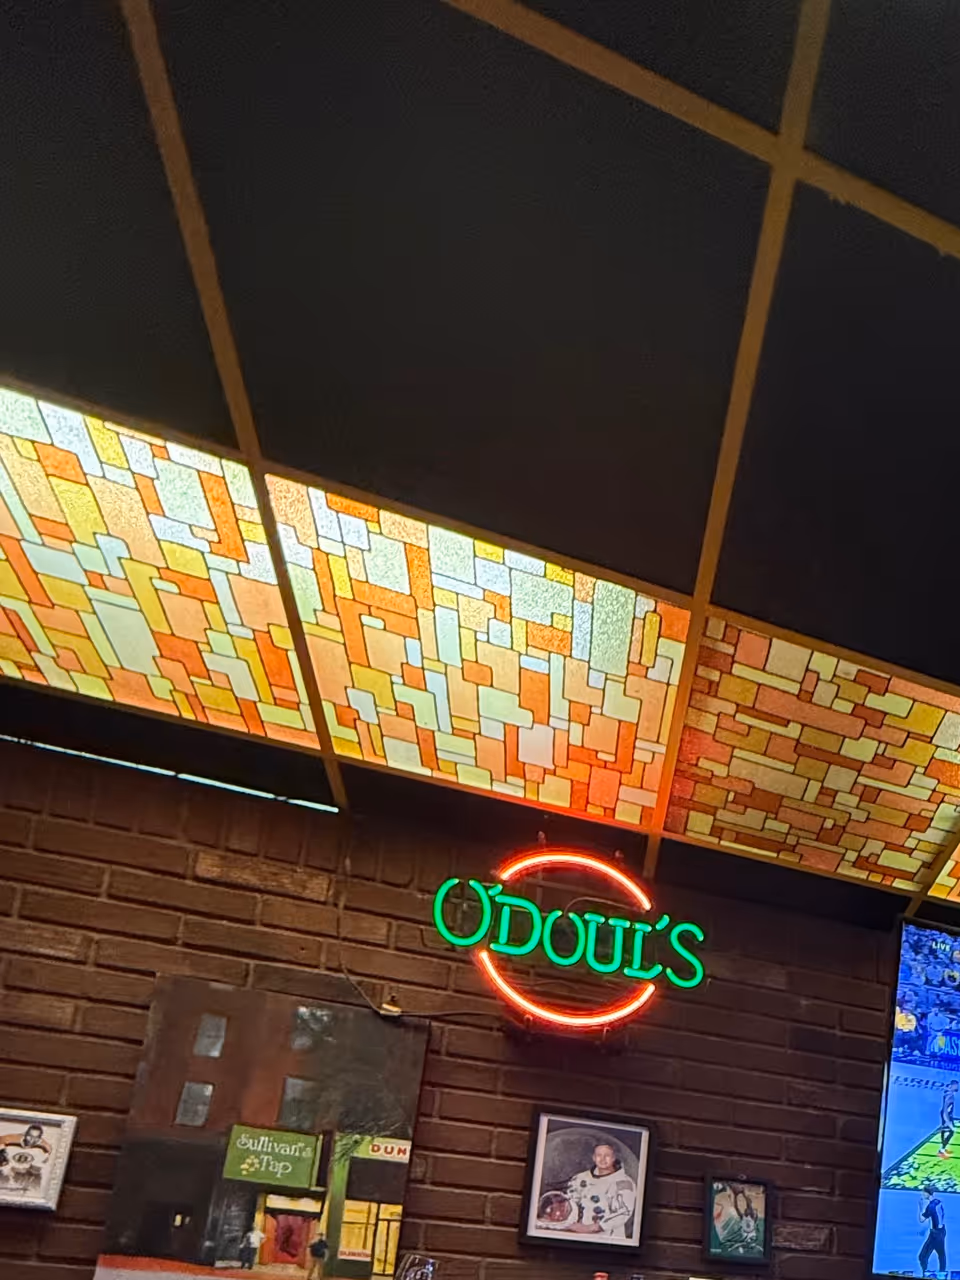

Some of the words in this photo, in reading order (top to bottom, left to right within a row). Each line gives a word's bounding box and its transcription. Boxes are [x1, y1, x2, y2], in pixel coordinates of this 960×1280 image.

[433, 877, 704, 989] O'DOUL'S
[932, 941, 951, 952] LIVE
[369, 1143, 408, 1157] DUN
[260, 1154, 292, 1178] Tap
